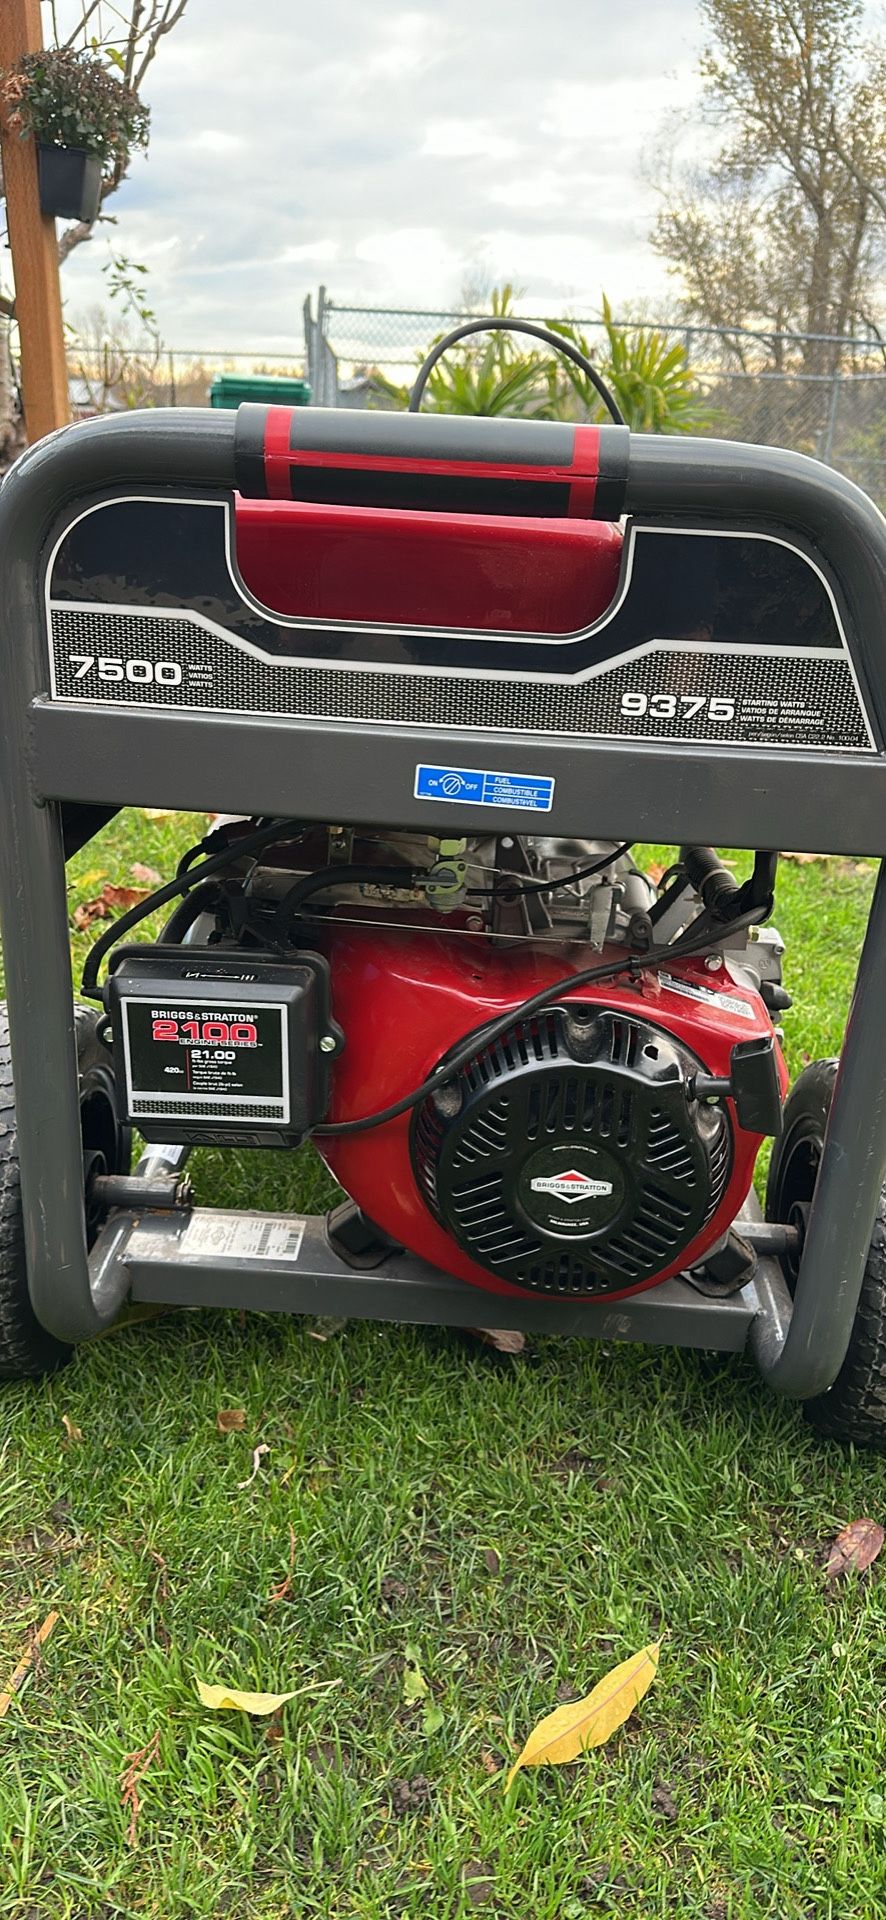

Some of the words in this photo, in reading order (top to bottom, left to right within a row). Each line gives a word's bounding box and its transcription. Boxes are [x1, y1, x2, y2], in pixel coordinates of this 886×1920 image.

[69, 655, 182, 686] 7500
[188, 664, 213, 672] WATTS
[188, 672, 213, 680] VATIOS
[188, 680, 213, 688] WATTS
[620, 692, 735, 721] 9375
[742, 699, 778, 707] STARTING
[741, 707, 766, 715] VATIOS
[740, 715, 765, 723] WATTS
[428, 779, 438, 787] ON
[494, 776, 512, 785] FUEL
[465, 782, 478, 791] OFF
[493, 786, 538, 797] COMBUSTIBLE
[152, 1020, 257, 1042] 2100
[179, 1038, 218, 1047] ENGINE
[191, 1049, 236, 1060] 21.00
